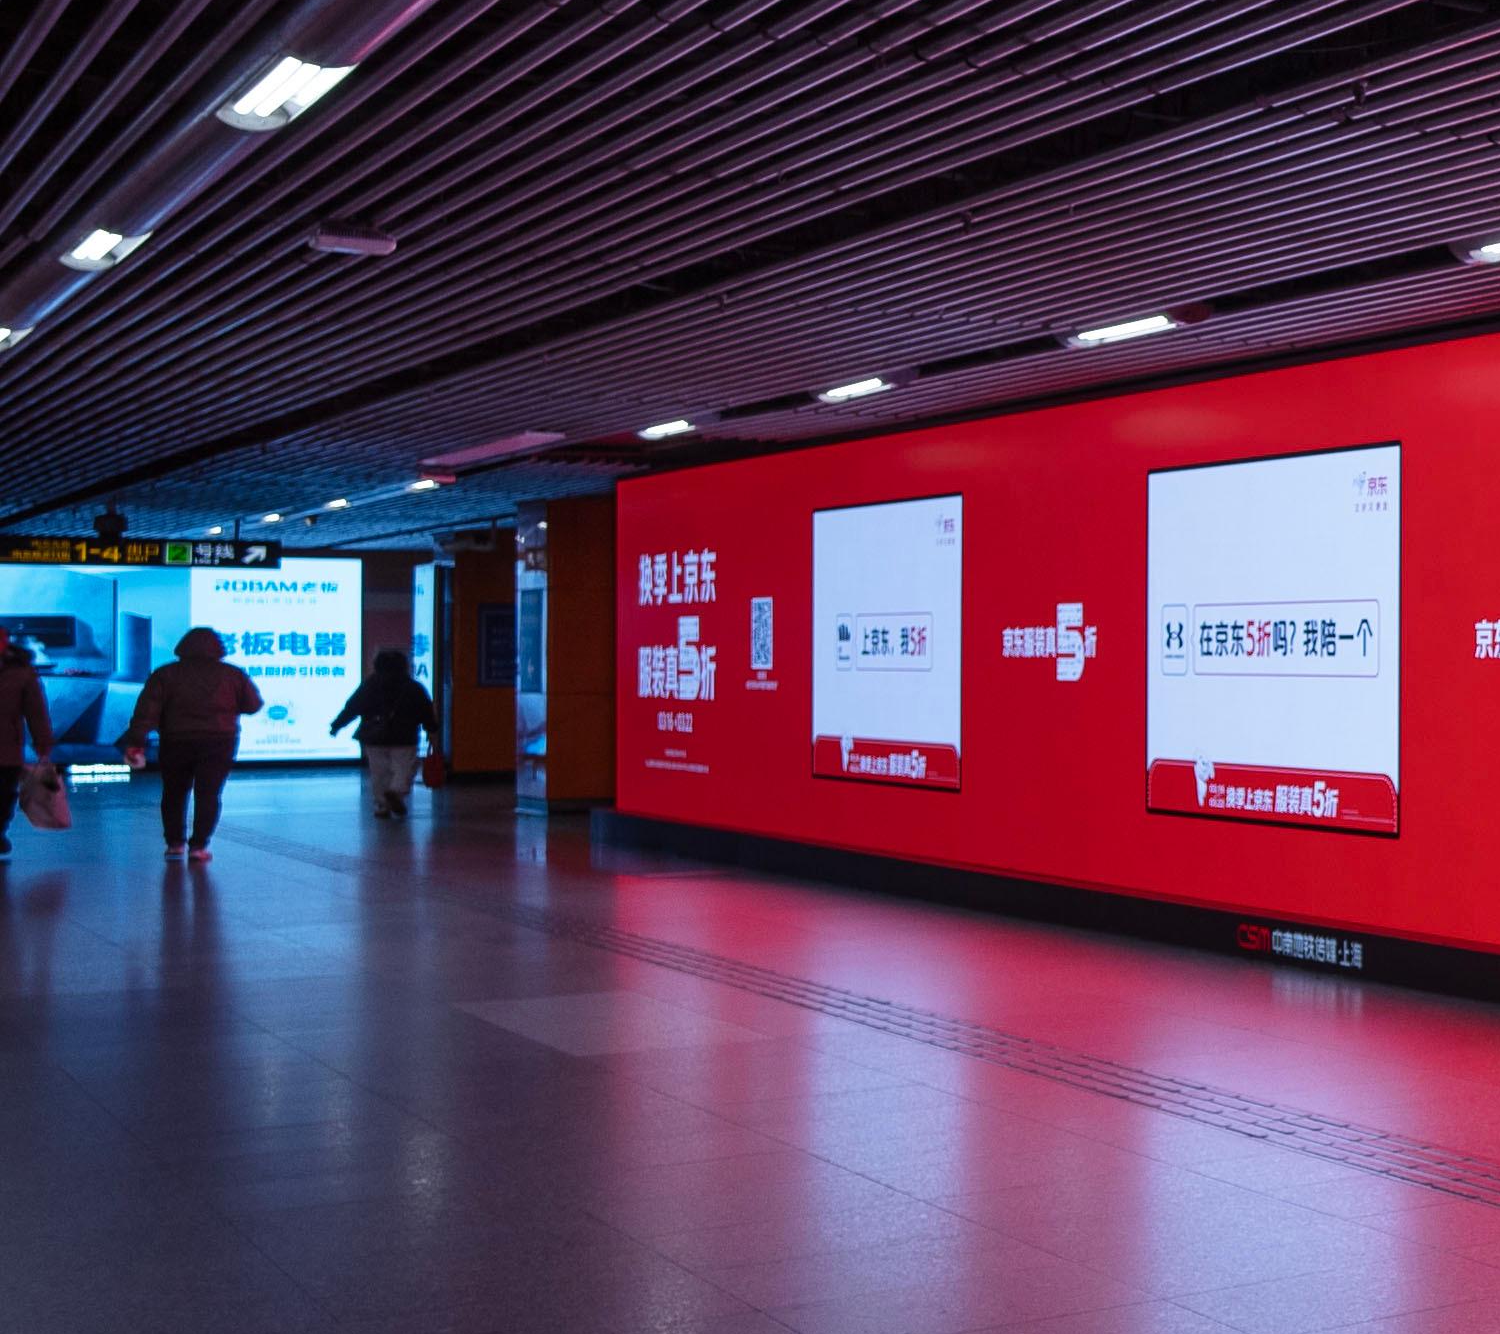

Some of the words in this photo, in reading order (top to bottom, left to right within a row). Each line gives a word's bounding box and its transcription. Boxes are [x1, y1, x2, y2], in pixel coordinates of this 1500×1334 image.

[1367, 476, 1388, 497] 京东
[74, 540, 122, 563] 1-4
[638, 547, 717, 606] 换季上京东
